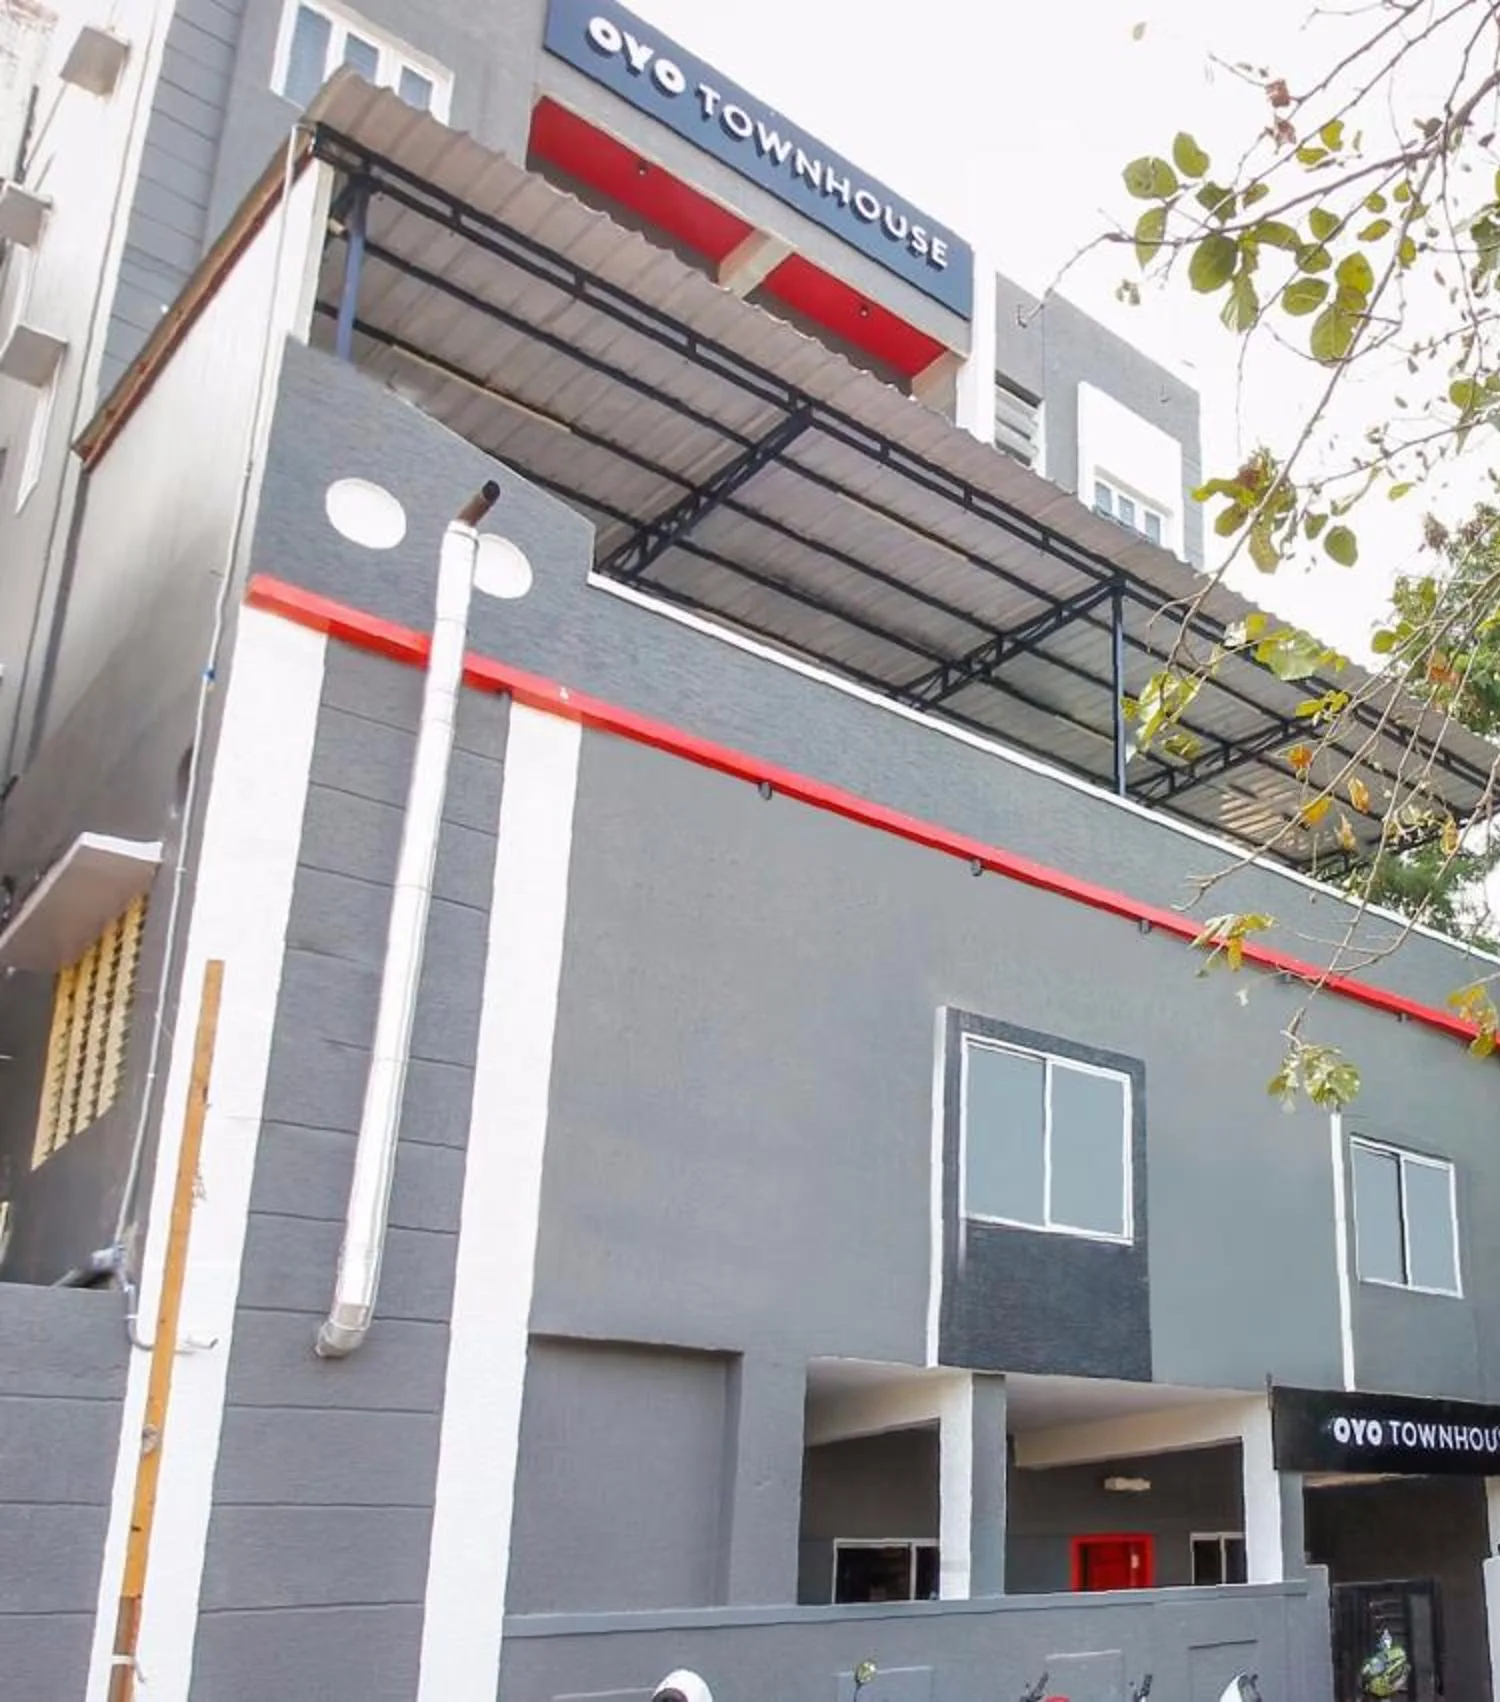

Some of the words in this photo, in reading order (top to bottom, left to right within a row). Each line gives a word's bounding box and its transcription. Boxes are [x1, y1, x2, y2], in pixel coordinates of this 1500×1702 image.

[587, 16, 687, 94] OYO
[697, 83, 950, 268] TOWNHOUSE
[1333, 1417, 1383, 1446] OYO
